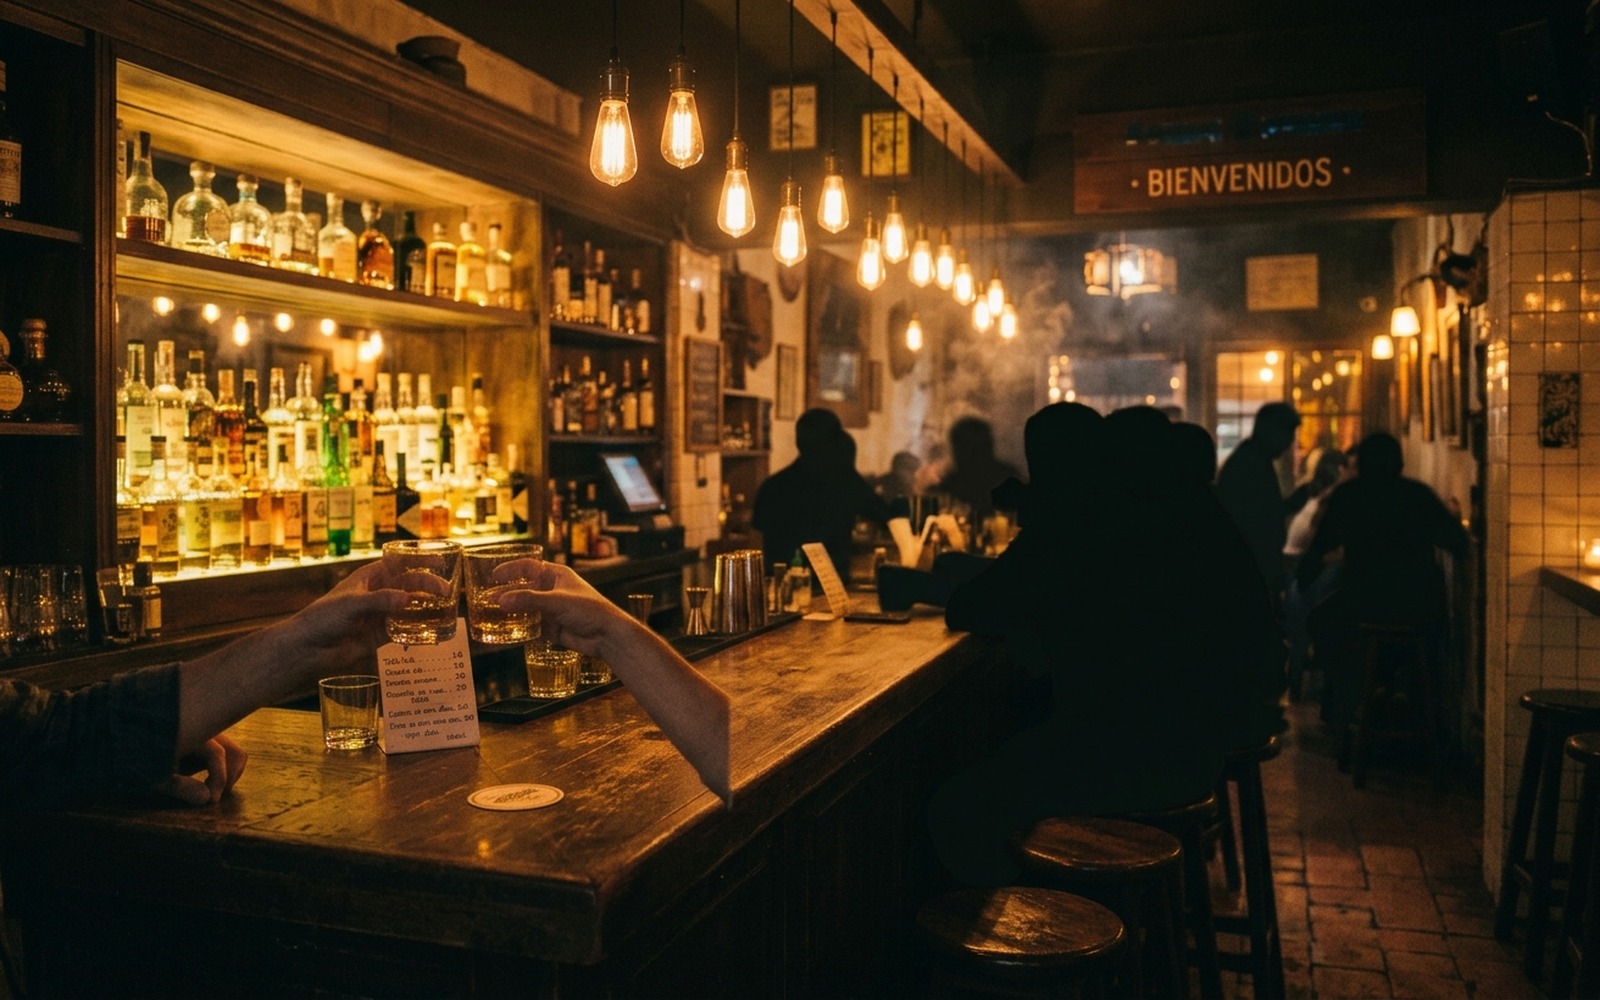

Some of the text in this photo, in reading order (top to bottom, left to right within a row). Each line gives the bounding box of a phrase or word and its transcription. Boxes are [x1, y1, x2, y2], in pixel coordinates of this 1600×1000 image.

[1148, 157, 1332, 197] BIENVENIDOS
[452, 651, 463, 659] 10
[456, 684, 467, 692] 20
